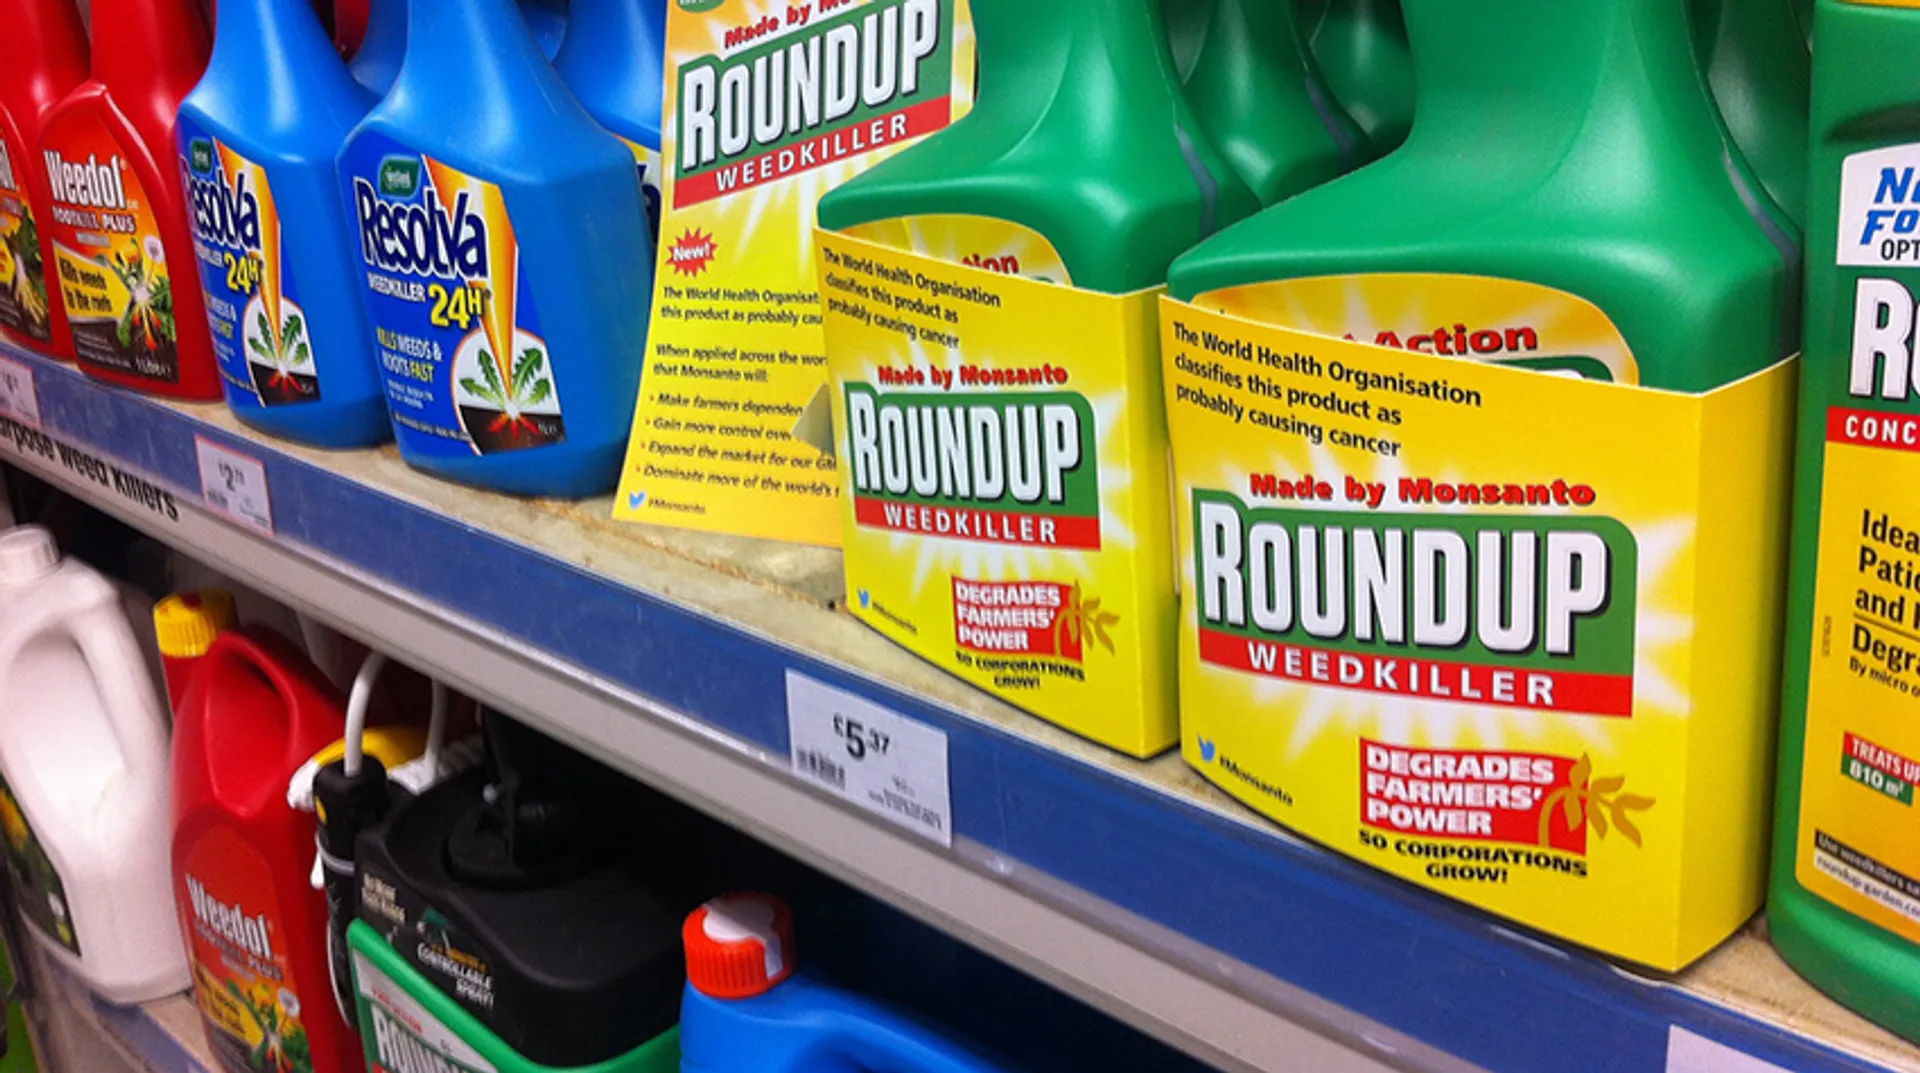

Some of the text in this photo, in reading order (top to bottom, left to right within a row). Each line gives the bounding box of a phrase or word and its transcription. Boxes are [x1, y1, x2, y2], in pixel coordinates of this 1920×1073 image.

[725, 15, 780, 49] Made
[786, 4, 812, 26] by
[682, 0, 940, 171] ROUNDUP
[715, 112, 909, 193] WEEDKILLER
[44, 150, 126, 210] Weedol
[101, 213, 136, 235] PLUS
[673, 243, 712, 262] New!
[663, 286, 683, 300] The
[685, 286, 721, 302] World
[722, 288, 760, 303] Health
[823, 246, 1002, 309] The World Health Organisation
[366, 272, 482, 330] WEEDKILLER 24H
[661, 305, 682, 318] this
[684, 306, 730, 322] product
[732, 310, 745, 321] as
[747, 309, 799, 328] probably
[825, 271, 959, 324] classifies this product as
[828, 297, 960, 349] probably causing cancer
[1850, 277, 1920, 402] R
[396, 332, 432, 361] WEEDS
[432, 341, 443, 362] &
[656, 343, 690, 357] When
[692, 346, 738, 362] applied
[740, 350, 776, 363] across
[779, 349, 799, 364] the
[1173, 320, 1482, 408] The World Health Organisation
[409, 360, 435, 383] FAST
[653, 362, 679, 377] that
[680, 364, 742, 381] Monsanto
[877, 363, 1069, 391] Made by Monsanto
[1174, 351, 1403, 426] classifies this product as
[658, 392, 690, 408] Make
[692, 394, 739, 412] farmers
[1175, 382, 1402, 457] probably causing cancer
[653, 418, 682, 431] Gain
[684, 421, 717, 434] more
[718, 425, 765, 440] control
[1844, 414, 1918, 446] CONC
[648, 440, 697, 459] Expand
[697, 446, 719, 459] the
[721, 449, 766, 465] market
[768, 452, 788, 466] for
[790, 456, 814, 469] our
[848, 391, 1081, 506] ROUNDUP
[643, 464, 705, 484] Dominate
[706, 472, 741, 488] more
[743, 475, 759, 490] of
[761, 476, 782, 491] the
[785, 481, 832, 498] world's
[1248, 472, 1597, 509] Made by Monsanto
[883, 502, 1058, 545] WEEDKILLER
[954, 579, 1062, 608] DEGRADES
[1198, 498, 1614, 658] ROUNDUP
[955, 602, 1056, 629] FARMERS'
[1855, 586, 1905, 625] and
[958, 623, 1029, 651] POWER
[955, 649, 1086, 683] SO CORPORATIONS
[993, 673, 1041, 690] GROW!
[1247, 640, 1556, 707] WEEDKILLER
[1849, 655, 1867, 678] By
[1869, 666, 1910, 695] micro
[1365, 743, 1556, 785] DEGRADES
[1849, 757, 1884, 791] 810
[1851, 736, 1902, 776] TREATS
[1365, 772, 1543, 811] FARMERS'
[1365, 802, 1493, 836] POWER
[1359, 829, 1589, 878] SO CORPORATIONS
[1426, 863, 1509, 885] GROW!
[185, 872, 273, 960] Weedol
